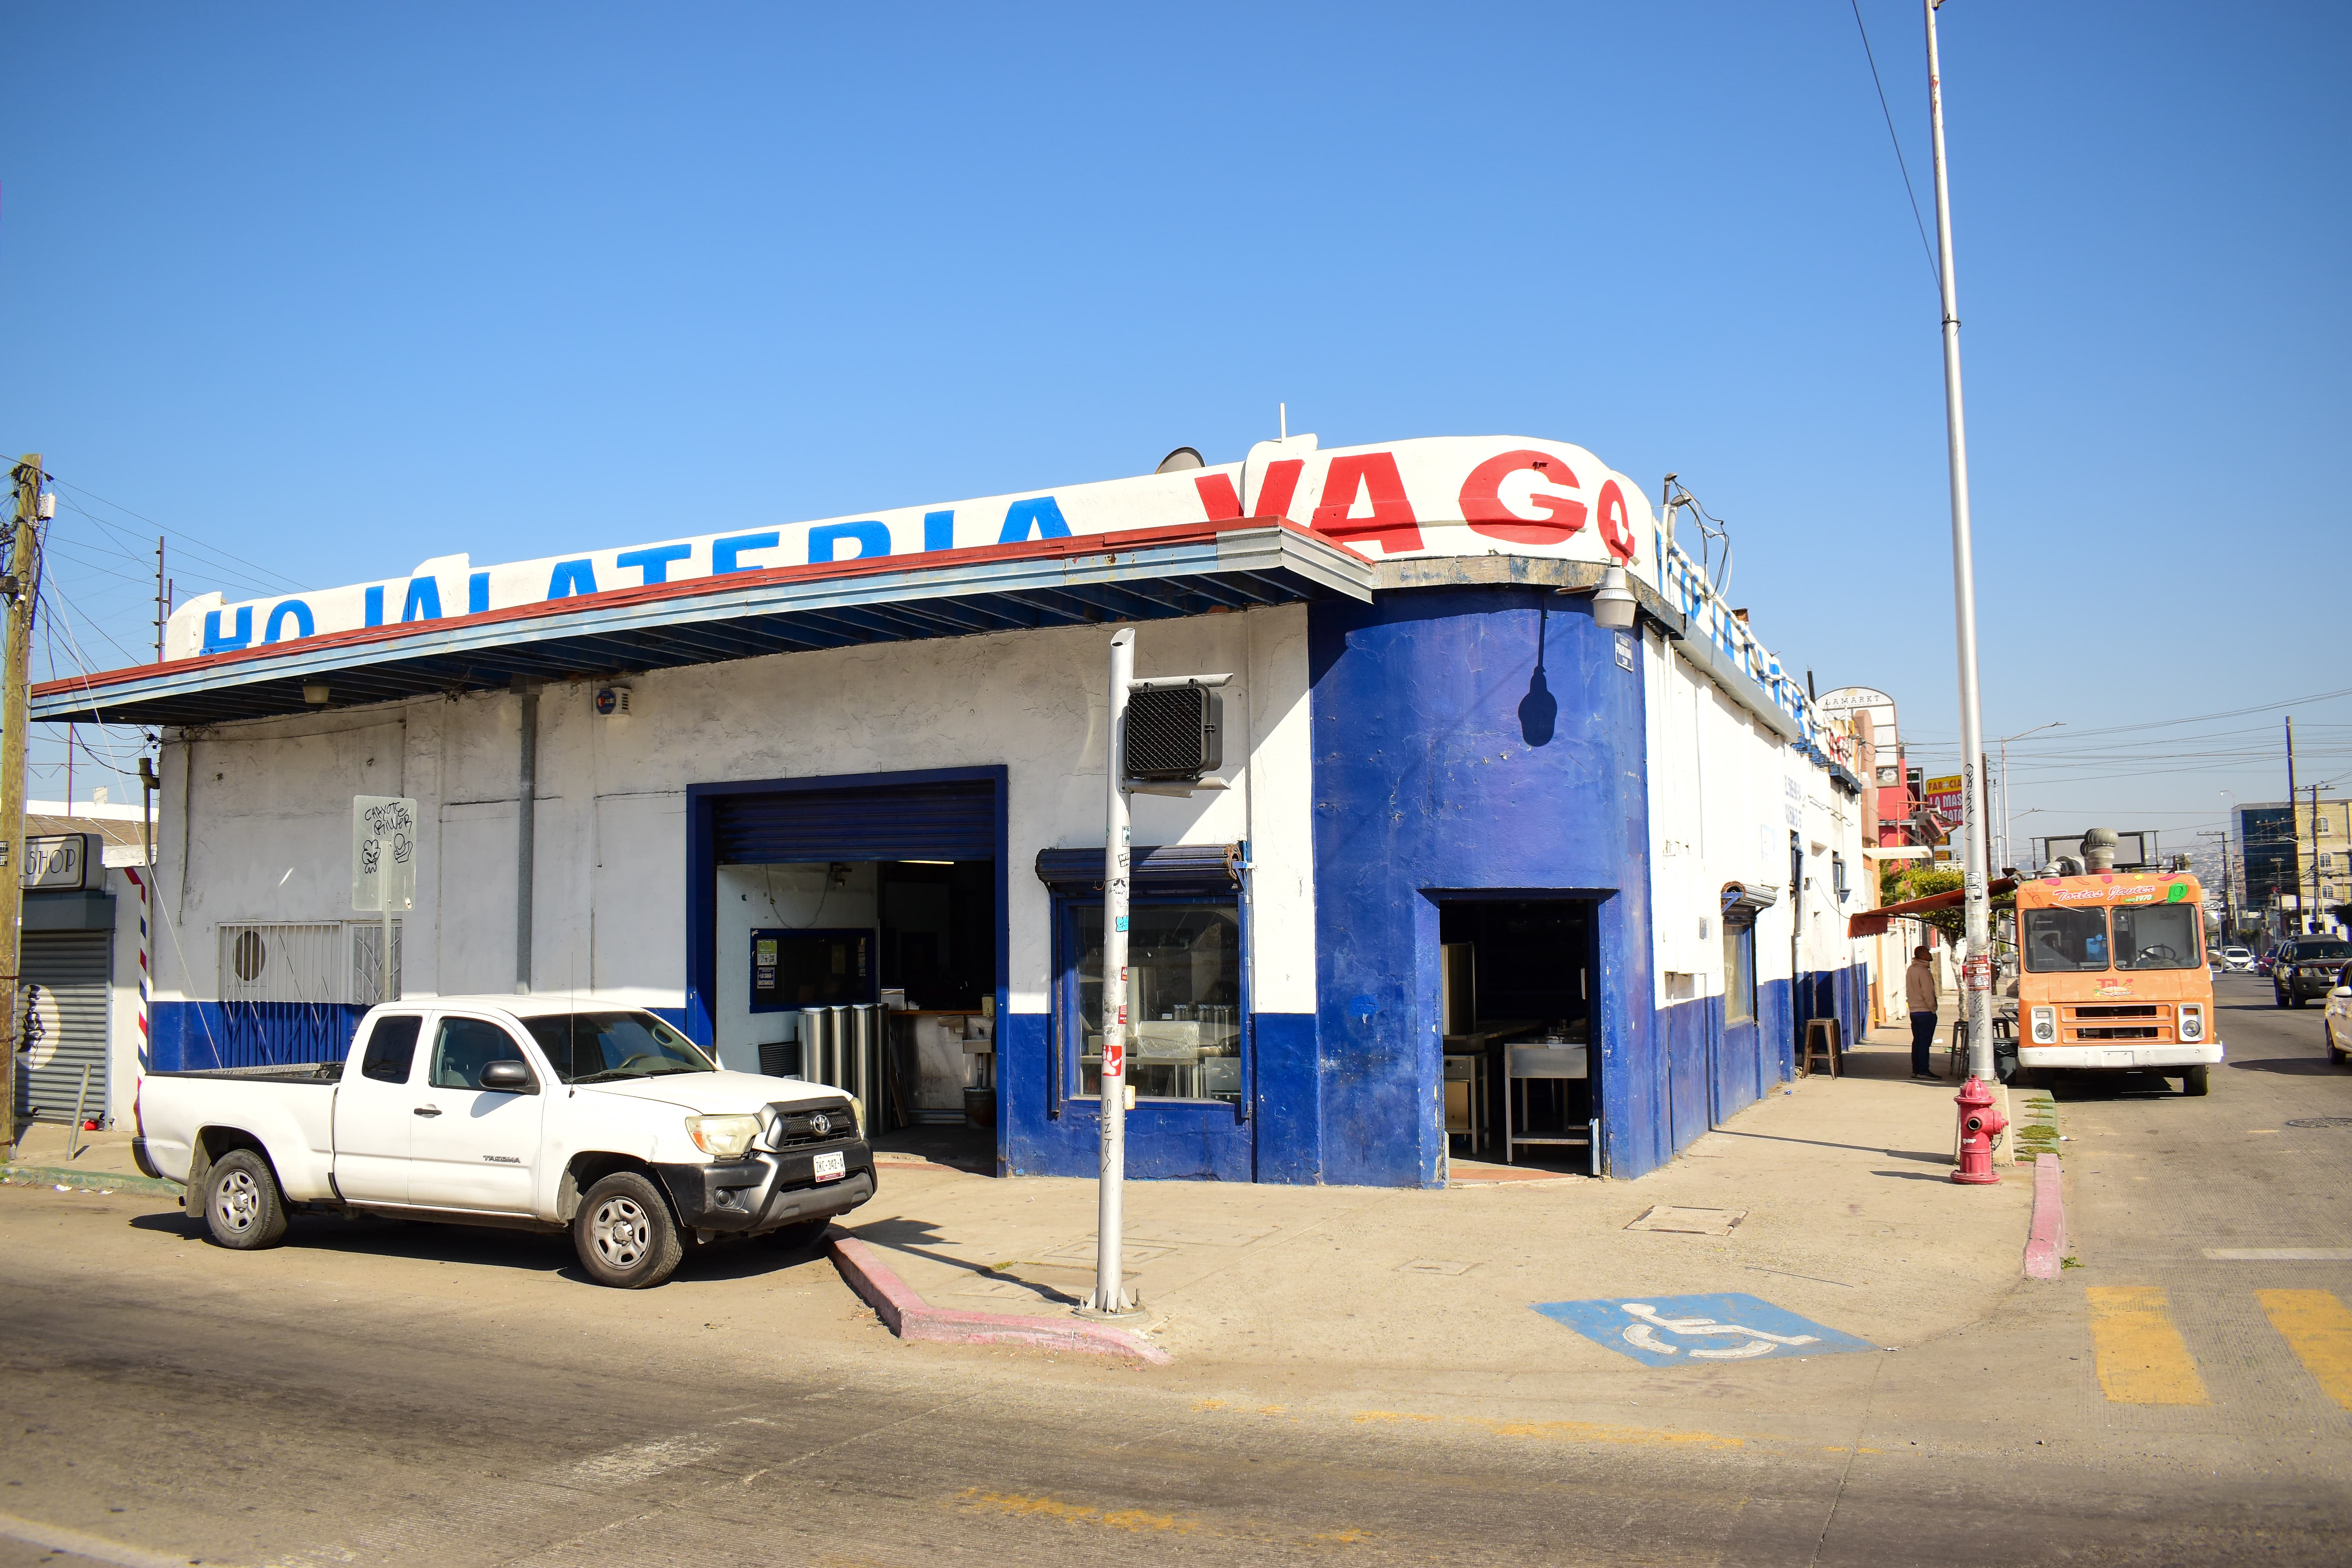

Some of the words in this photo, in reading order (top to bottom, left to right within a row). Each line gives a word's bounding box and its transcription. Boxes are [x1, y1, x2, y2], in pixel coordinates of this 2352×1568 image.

[1194, 449, 1635, 568] VAGO
[1825, 695, 1880, 706] LAMARKT
[1943, 793, 1962, 808] MAS
[25, 849, 76, 875] SHOP
[2053, 889, 2104, 902] Tortas
[2107, 885, 2156, 901] Javier
[483, 1155, 521, 1163] TACOMA
